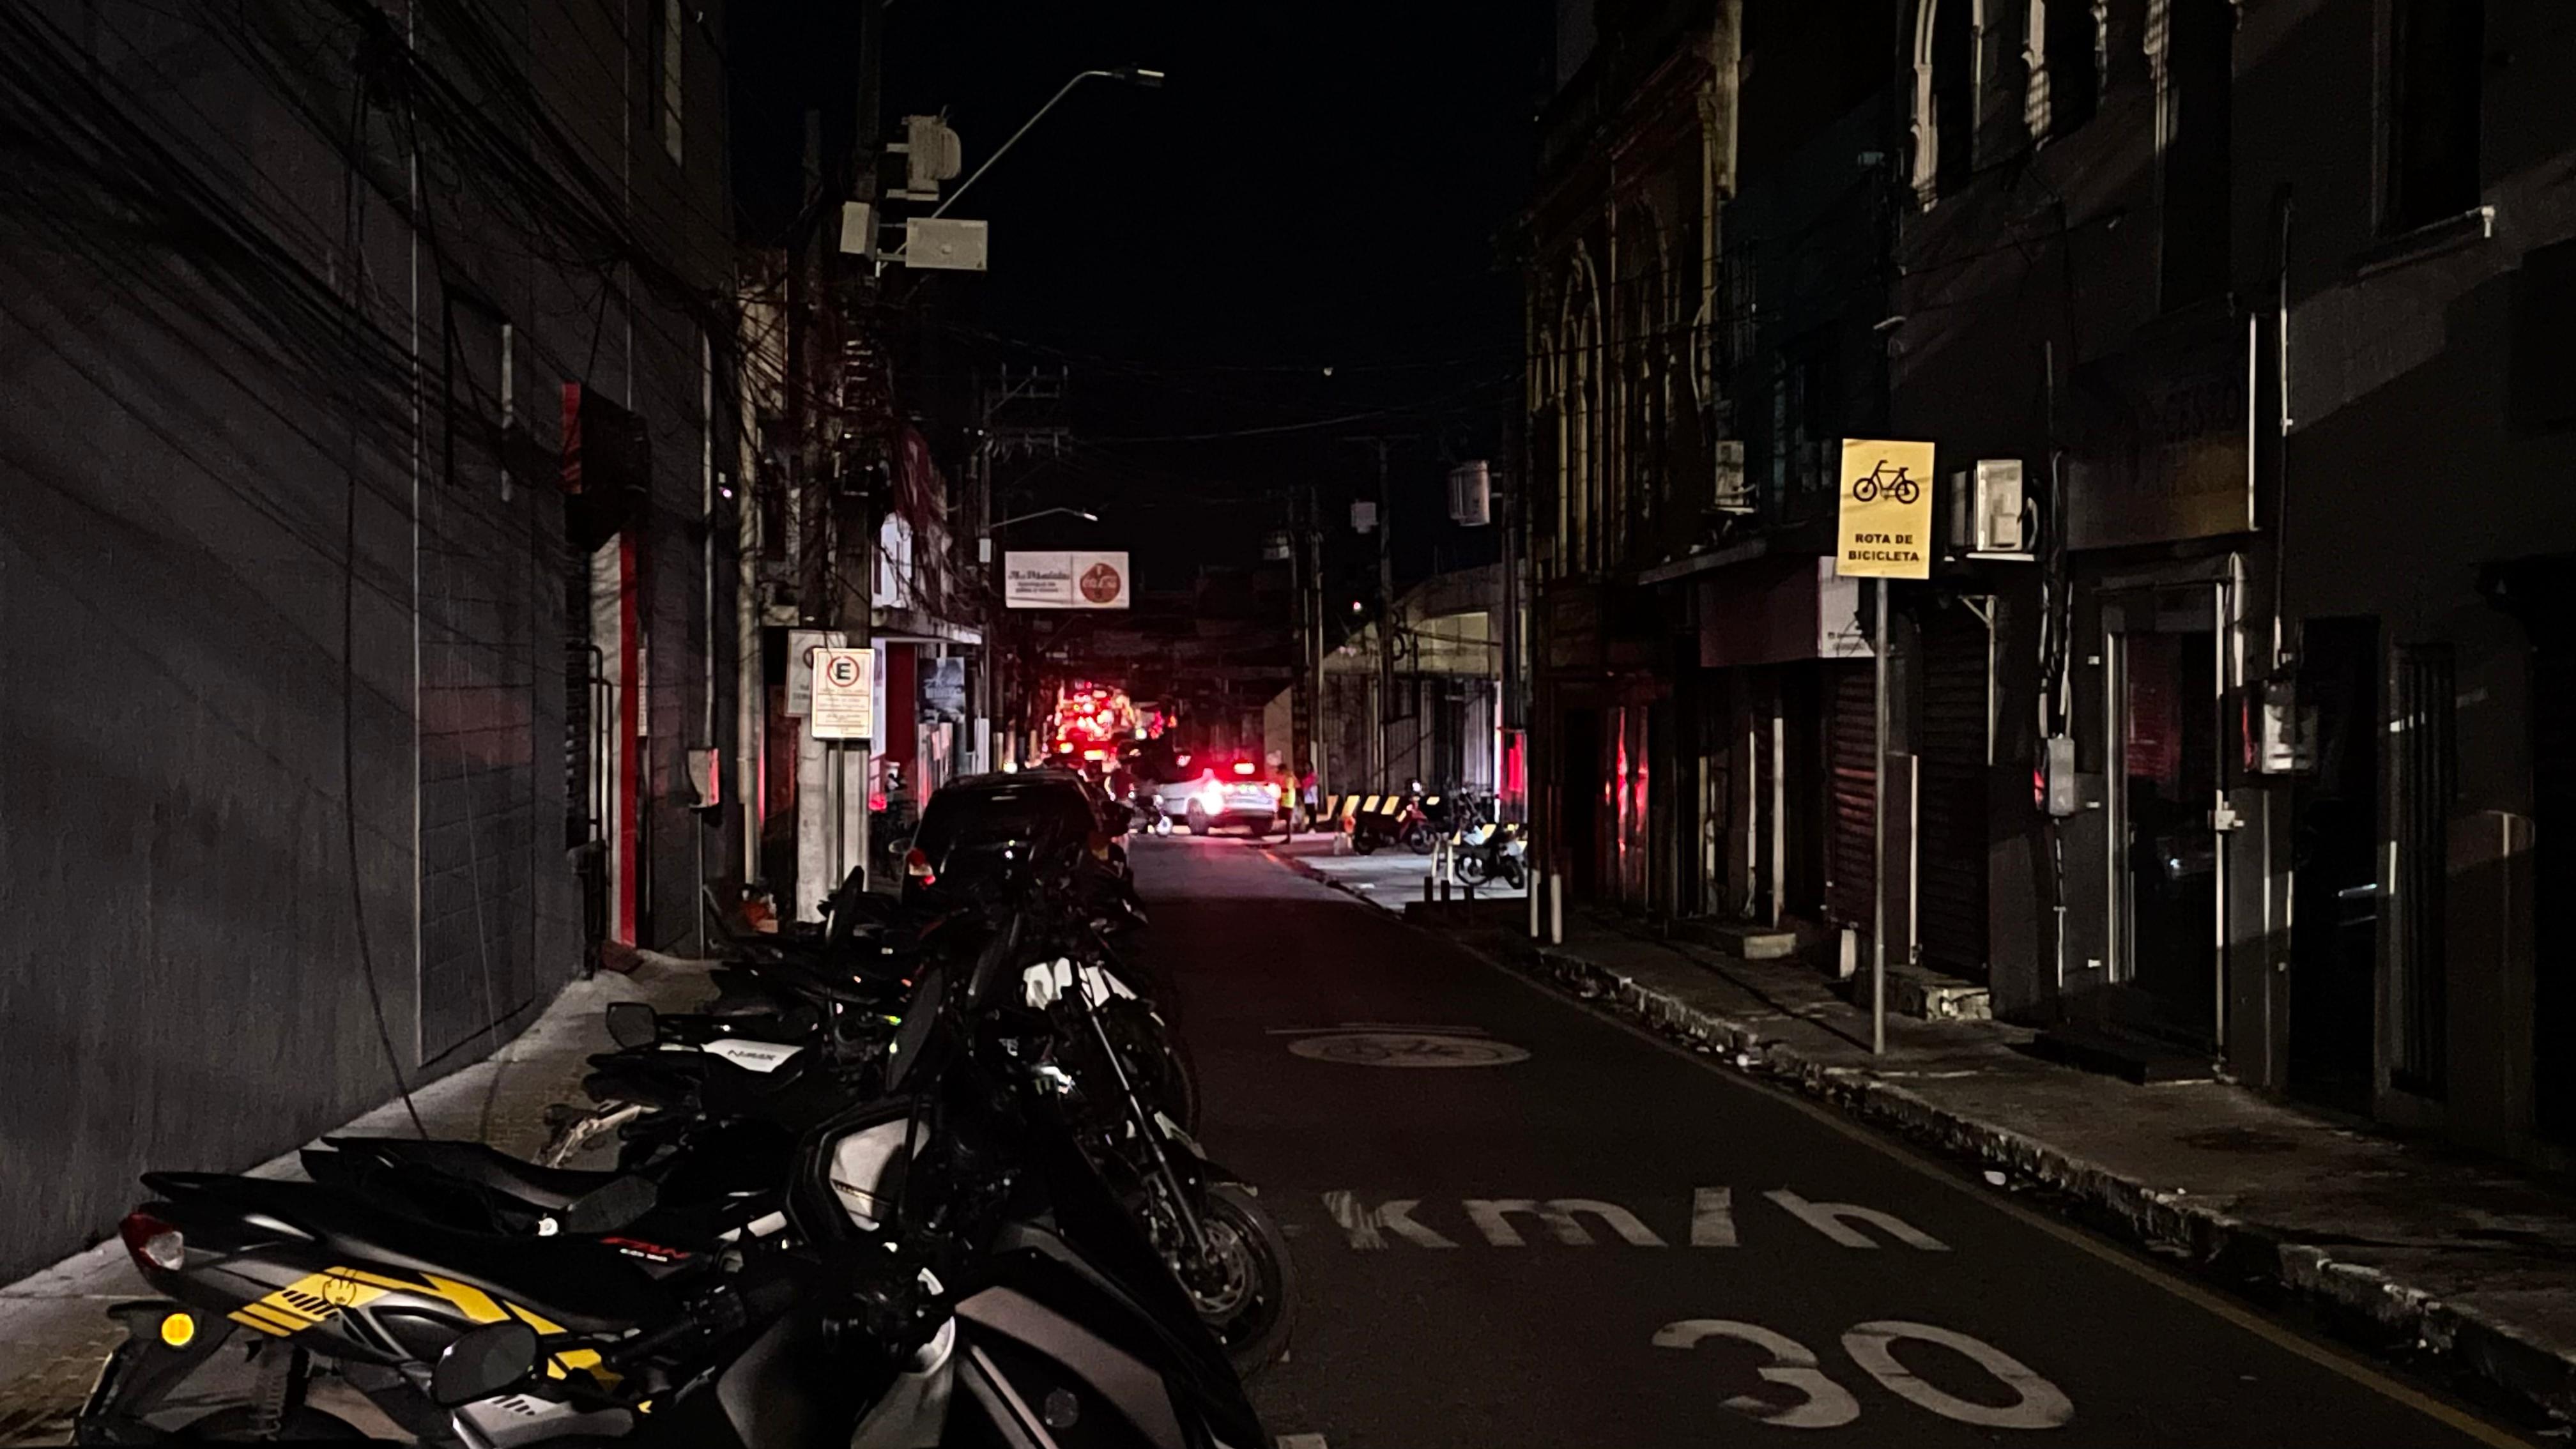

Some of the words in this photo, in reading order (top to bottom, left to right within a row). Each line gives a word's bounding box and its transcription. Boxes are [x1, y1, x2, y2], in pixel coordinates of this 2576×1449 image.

[1855, 533, 1891, 544] ROTA
[1895, 535, 1913, 544] DE
[1848, 550, 1920, 562] BICICLETA
[836, 663, 851, 680] E
[1651, 1319, 2074, 1429] 30
